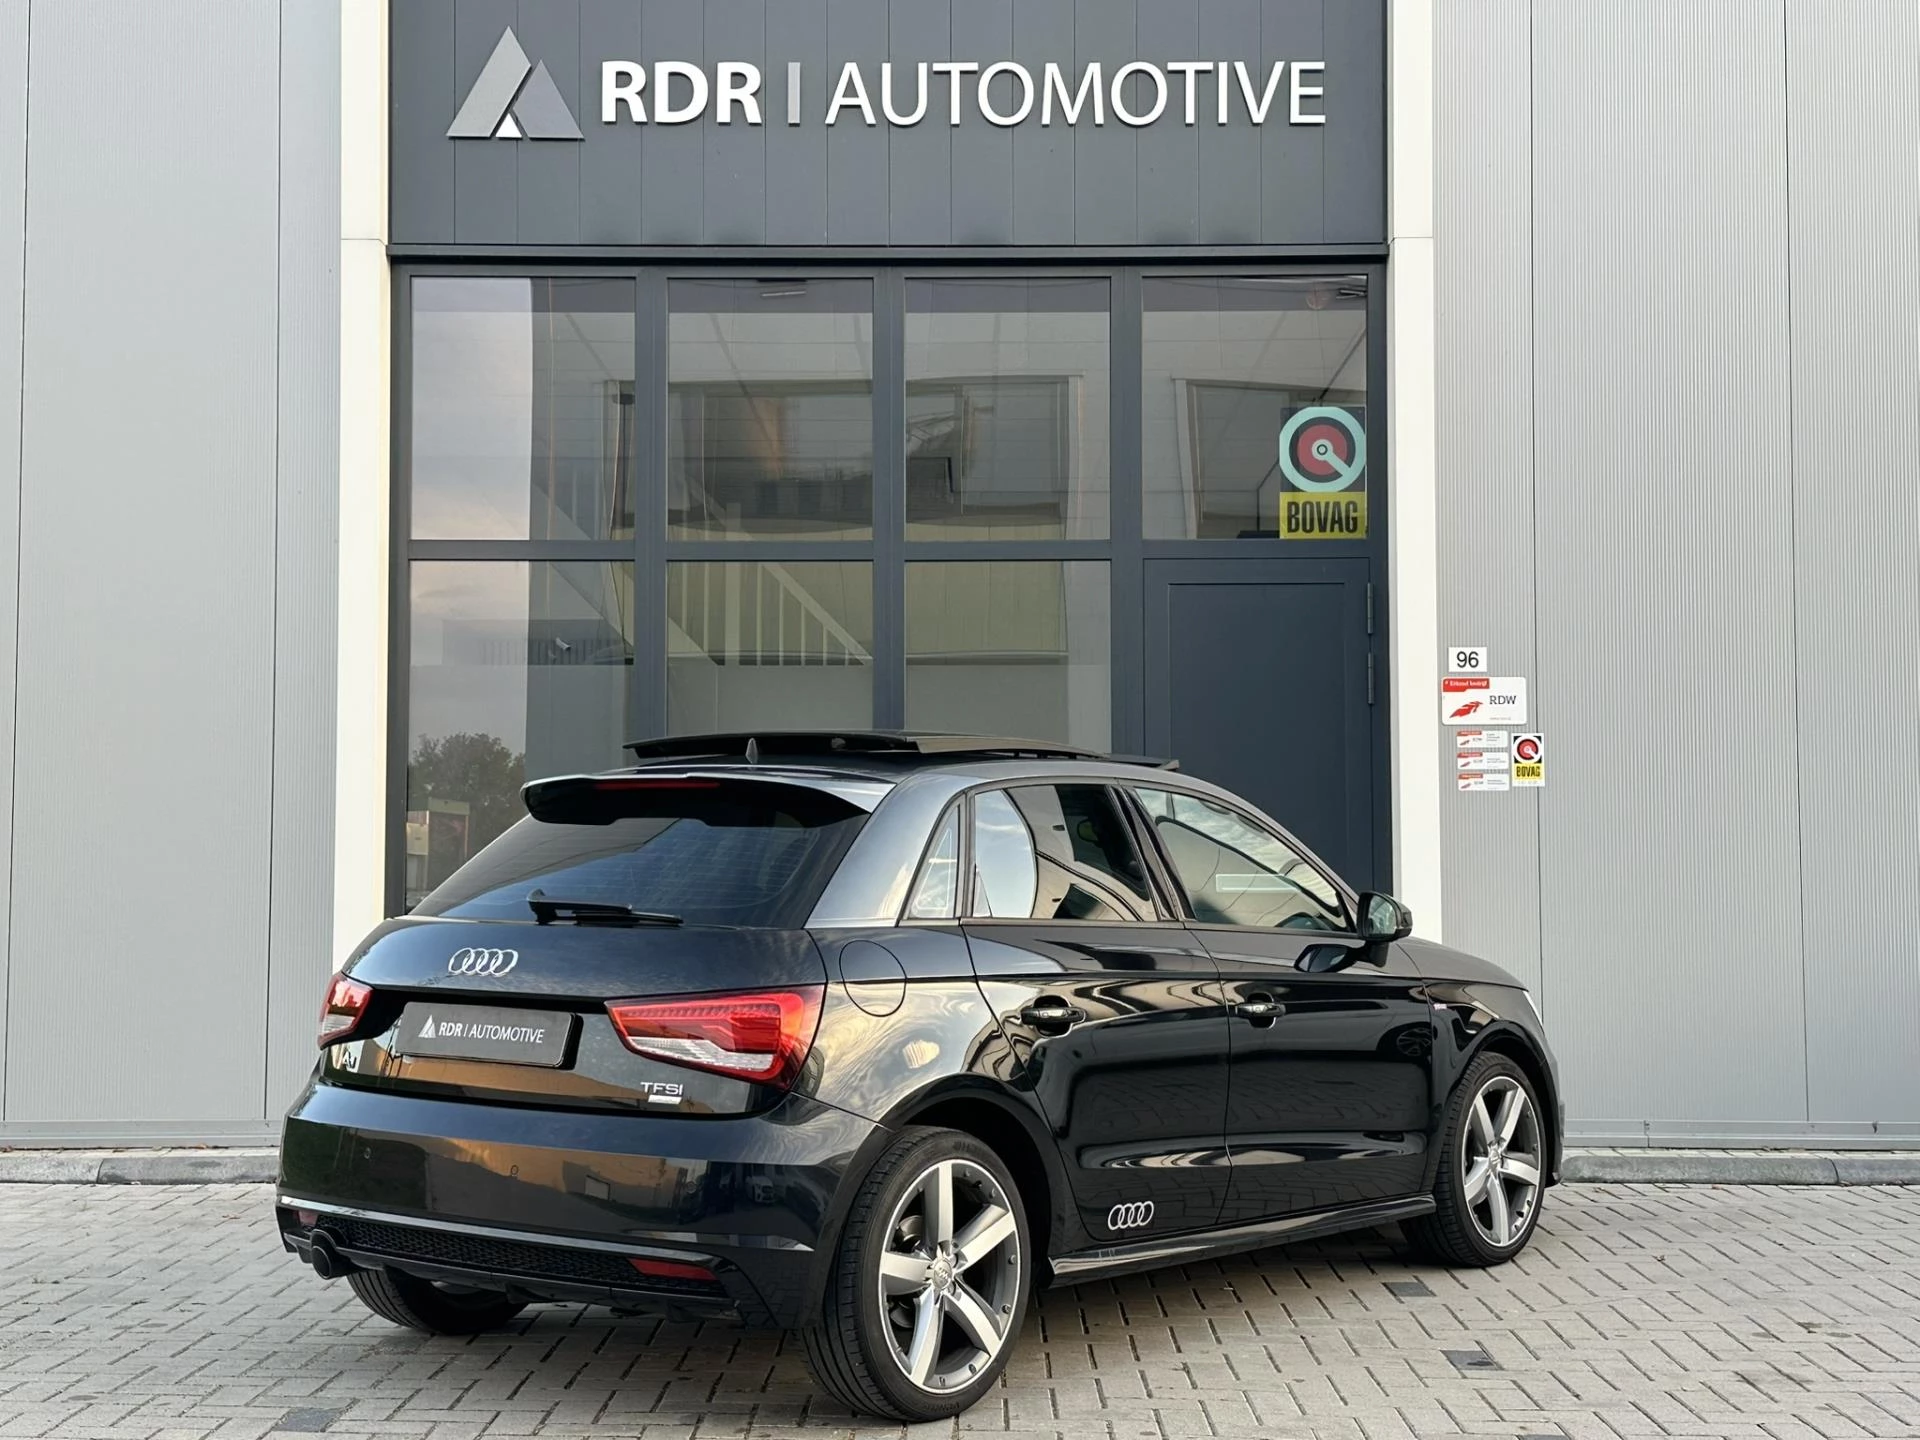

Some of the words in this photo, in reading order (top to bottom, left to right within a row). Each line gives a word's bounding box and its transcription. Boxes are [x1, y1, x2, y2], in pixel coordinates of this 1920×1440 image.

[601, 60, 763, 125] RDR
[825, 60, 1327, 126] AUTOMOTIVE
[1286, 500, 1358, 534] BOVAG
[1456, 650, 1480, 669] 96
[1489, 695, 1517, 705] RDW
[1516, 765, 1541, 778] BOVAG
[438, 1021, 463, 1037] RDR
[468, 1023, 546, 1044] AUTOMOTIVE
[640, 1081, 684, 1096] TFSI
